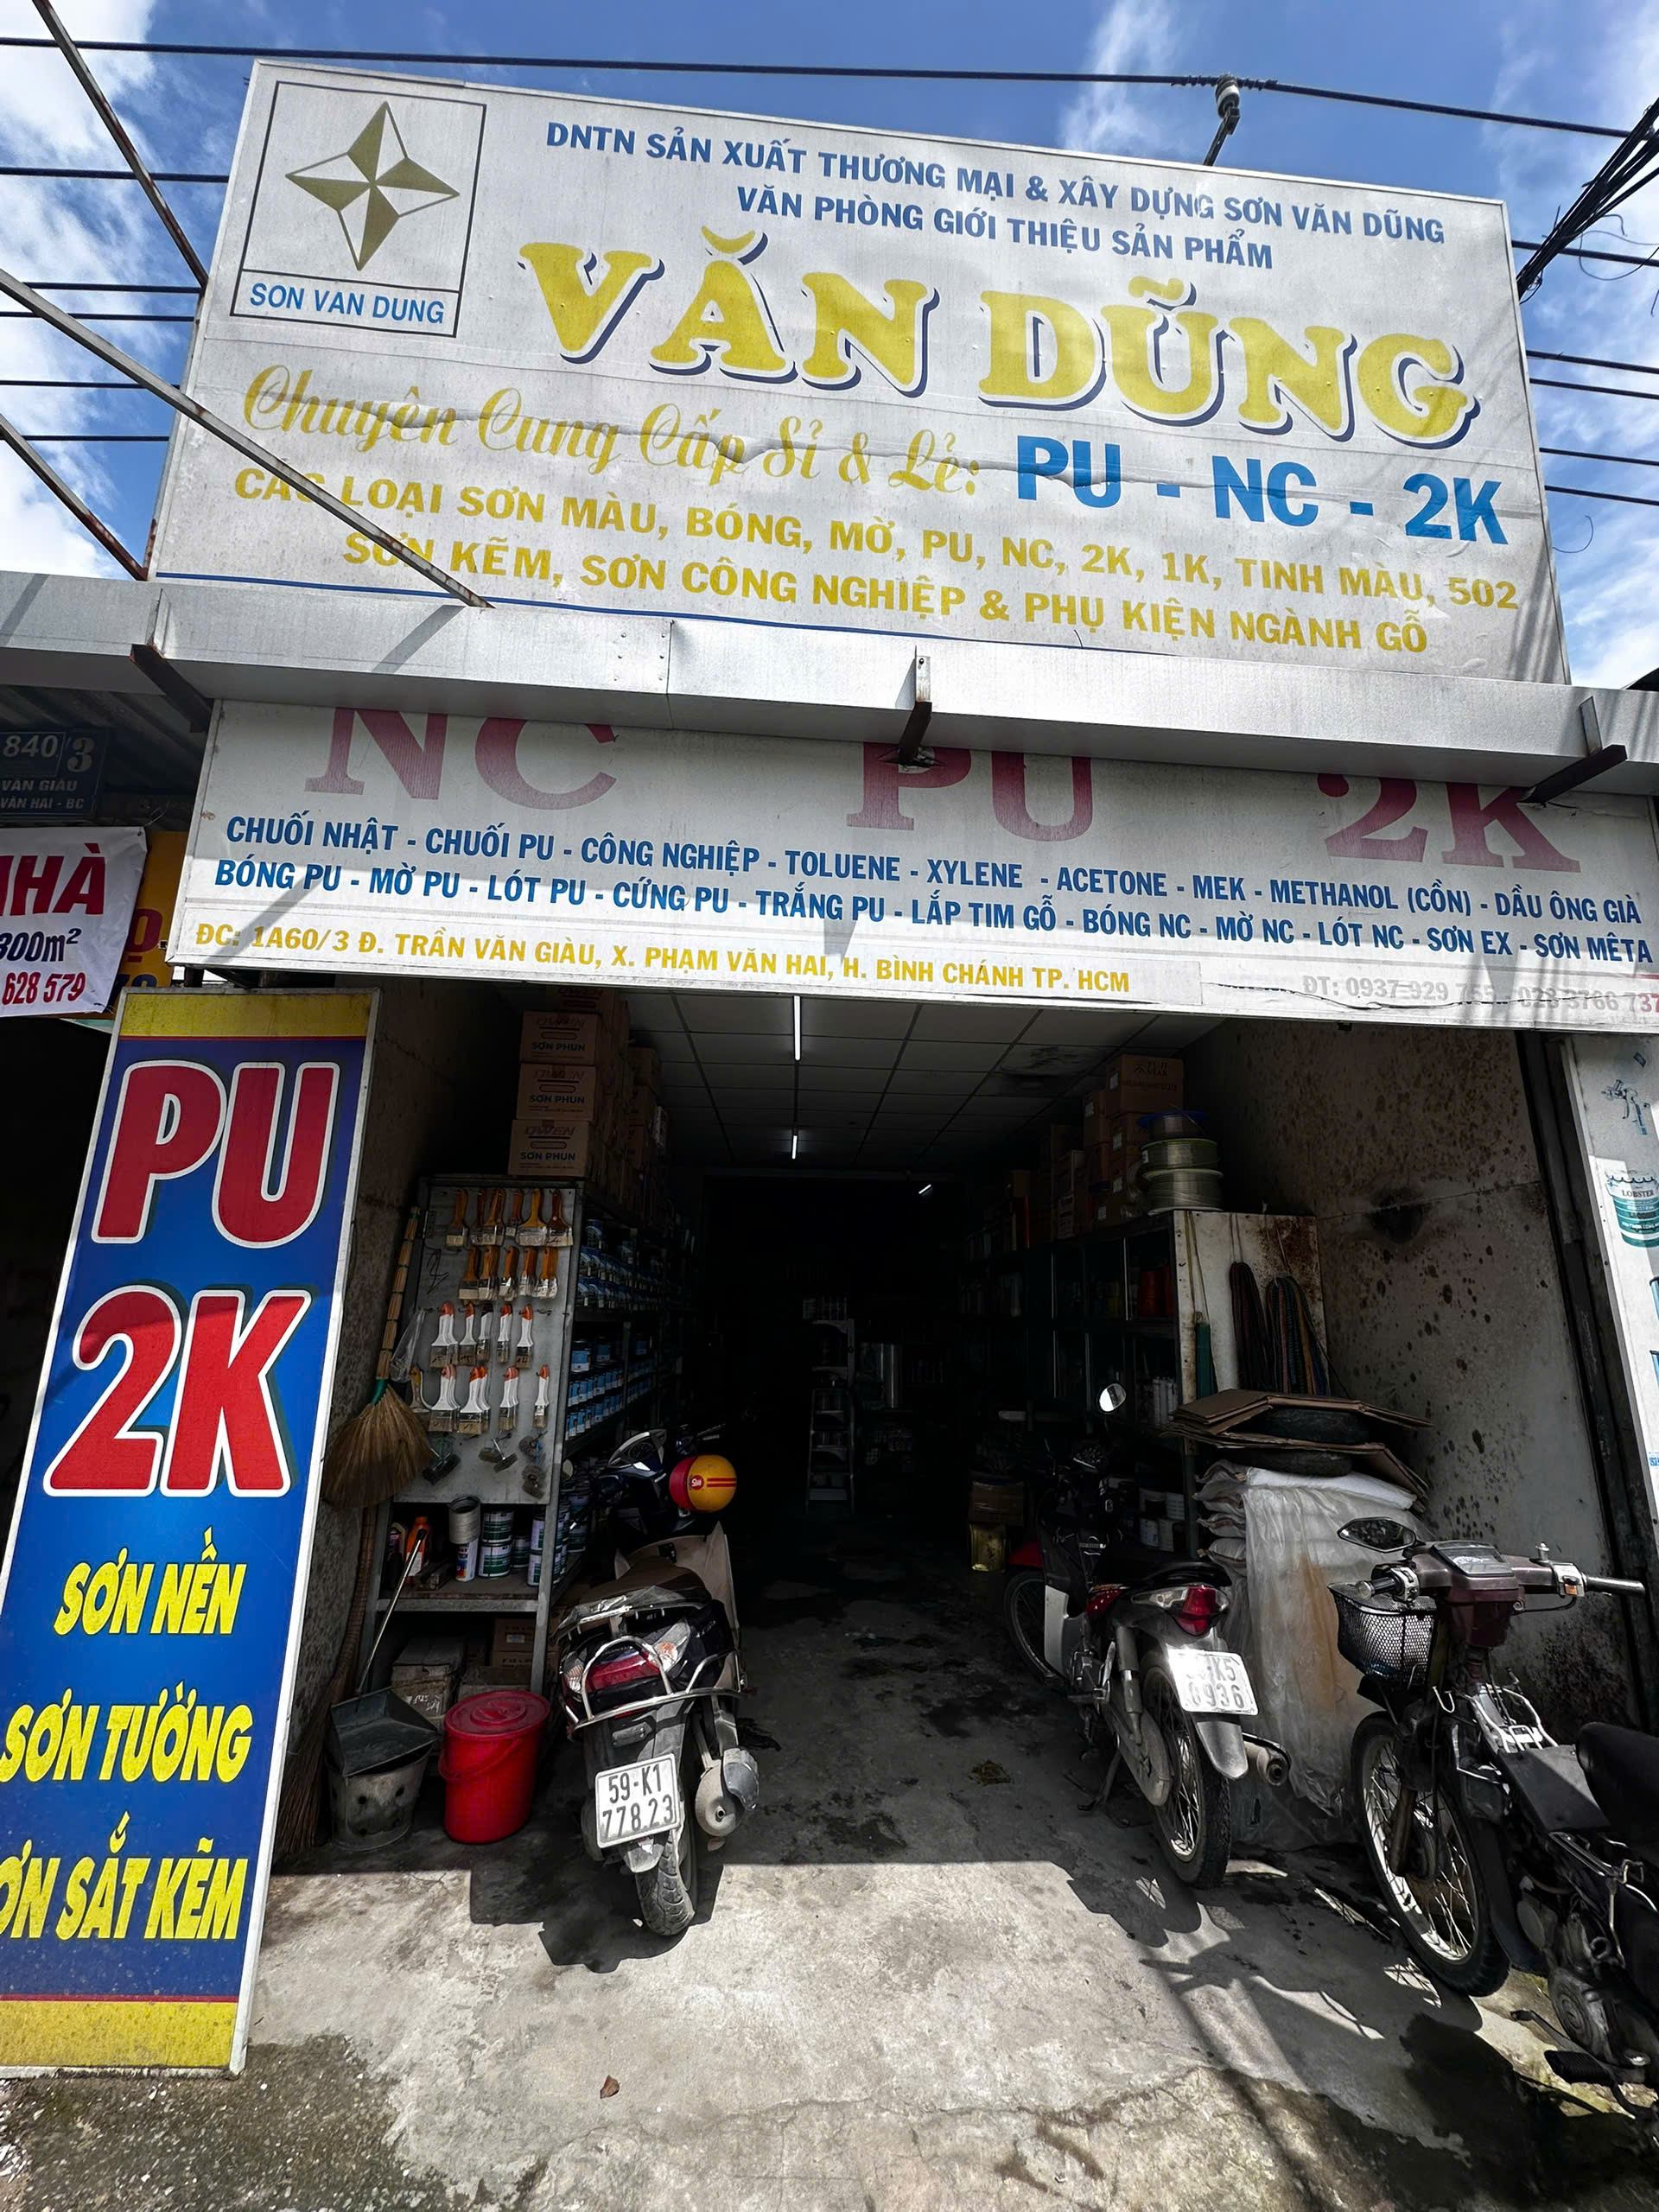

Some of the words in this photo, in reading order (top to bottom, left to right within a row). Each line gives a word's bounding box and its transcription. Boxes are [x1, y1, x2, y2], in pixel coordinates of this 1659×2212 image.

[547, 122, 634, 155] DNTN
[646, 127, 711, 162] SẢN
[723, 138, 806, 173] XUẤT
[819, 152, 944, 187] THƯƠNG
[957, 168, 1014, 197] MẠI
[1026, 176, 1047, 200] &
[1059, 176, 1117, 207] XÂY
[1132, 187, 1213, 218] DỰNG
[1224, 198, 1281, 226] SƠN
[1293, 206, 1351, 234] VĂN
[1363, 210, 1444, 242] DŨNG
[738, 187, 802, 218] VĂN
[815, 194, 922, 229] PHÒNG
[934, 207, 995, 238] GIỚI
[1007, 219, 1099, 251] THIỆU
[1113, 224, 1172, 257] SẢN
[1185, 229, 1272, 269] PHẨM
[250, 283, 304, 309] SON
[315, 290, 365, 316] VAN
[373, 296, 442, 324] DUNG
[518, 226, 939, 399] VĂN
[978, 276, 1481, 449] DŨNG
[477, 388, 621, 474] Cung
[839, 433, 870, 484] &
[1017, 435, 1121, 508] PU
[1212, 456, 1319, 526] NC
[1403, 473, 1507, 544] 2K
[339, 477, 442, 518] LOẠI
[456, 486, 544, 523] SƠN
[562, 493, 668, 539] MÀU,
[686, 503, 812, 553] BÓNG,
[830, 517, 906, 561] MỜ,
[923, 530, 985, 569] PU,
[1002, 537, 1065, 575] NC,
[1081, 544, 1144, 582] 2K,
[1162, 553, 1221, 589] 1K,
[1236, 558, 1324, 594] TINH
[1338, 564, 1434, 605] MÀU,
[1448, 577, 1518, 609] 502
[450, 537, 563, 588] KẼM,
[581, 554, 666, 590] SƠN
[682, 557, 796, 603] CÔNG
[812, 574, 965, 620] NGHIỆP
[979, 590, 1009, 621] &
[1025, 593, 1104, 633] PHỤ
[1122, 598, 1215, 641] KIỆN
[1230, 608, 1362, 650] NGÀNH
[1376, 610, 1427, 652] GỖ
[3, 734, 59, 758] 840
[304, 707, 618, 810] NC
[847, 743, 1093, 842] PU
[1317, 774, 1580, 873] 2K
[215, 854, 295, 889] BÓNG
[303, 864, 341, 891] PU
[370, 862, 416, 895] MỜ
[423, 871, 460, 898] PU
[488, 870, 541, 902] LÓT
[550, 878, 585, 906] PU
[613, 877, 684, 911] CỨNG
[695, 887, 728, 912] PU
[756, 881, 842, 919] TRẮNG
[852, 896, 885, 922] PU
[912, 890, 961, 925] LẮP
[968, 903, 1014, 928] TIM
[1023, 895, 1056, 931] GỖ
[1083, 904, 1150, 937] BÓNG
[1159, 913, 1191, 938] NC
[1217, 912, 1253, 941] MỜ
[1262, 919, 1294, 944] NC
[1319, 917, 1362, 946] LÓT
[1372, 925, 1403, 949] NC
[1427, 926, 1474, 953] SƠN
[1480, 931, 1512, 954] EX
[1535, 932, 1580, 958] SƠN
[1586, 932, 1652, 963] MÊTA
[227, 810, 314, 845] CHUỐI
[323, 817, 398, 855] NHẬT
[425, 823, 509, 857] CHUỐI
[518, 834, 553, 860] PU
[582, 832, 653, 866] CÔNG
[663, 840, 760, 876] NGHIỆP
[785, 850, 899, 881] TOLUENE
[927, 859, 1023, 888] XYLENE
[1058, 868, 1167, 896] ACETONE
[1193, 874, 1245, 900] MEK
[1270, 879, 1398, 909] METHANOL
[1408, 879, 1471, 916] (CỒN)
[1495, 885, 1541, 918] DẦU
[1550, 891, 1597, 922] ÔNG
[1604, 895, 1641, 924] GIÀ
[3, 972, 41, 1005] 628
[43, 972, 86, 1003] 579
[196, 924, 241, 947] ĐC:
[359, 931, 384, 954] Đ.
[395, 928, 465, 958] TRẦN
[475, 932, 525, 961] VĂN
[534, 938, 601, 968] GIÀU,
[611, 946, 633, 967] X.
[645, 947, 718, 973] PHẠM
[728, 949, 776, 974] VĂN
[786, 954, 833, 980] HAI,
[843, 957, 866, 978] H.
[876, 956, 933, 982] BÌNH
[942, 961, 1023, 987] CHÁNH
[1033, 968, 1068, 988] TP.
[1078, 970, 1129, 993] HCM
[556, 1096, 585, 1104] PHUN
[92, 1059, 340, 1248] PU
[545, 1153, 575, 1161] PHUN
[1622, 1189, 1655, 1198] LOBSTER
[43, 1286, 312, 1497] 2K
[54, 1548, 152, 1635] SƠN
[151, 1530, 245, 1634] NỀN
[0, 1690, 99, 1783] SƠN
[99, 1684, 252, 1783] TƯỜNG
[608, 1764, 662, 1803] 59-K1
[55, 1815, 149, 1941] SẮT
[145, 1839, 247, 1940] KẼM
